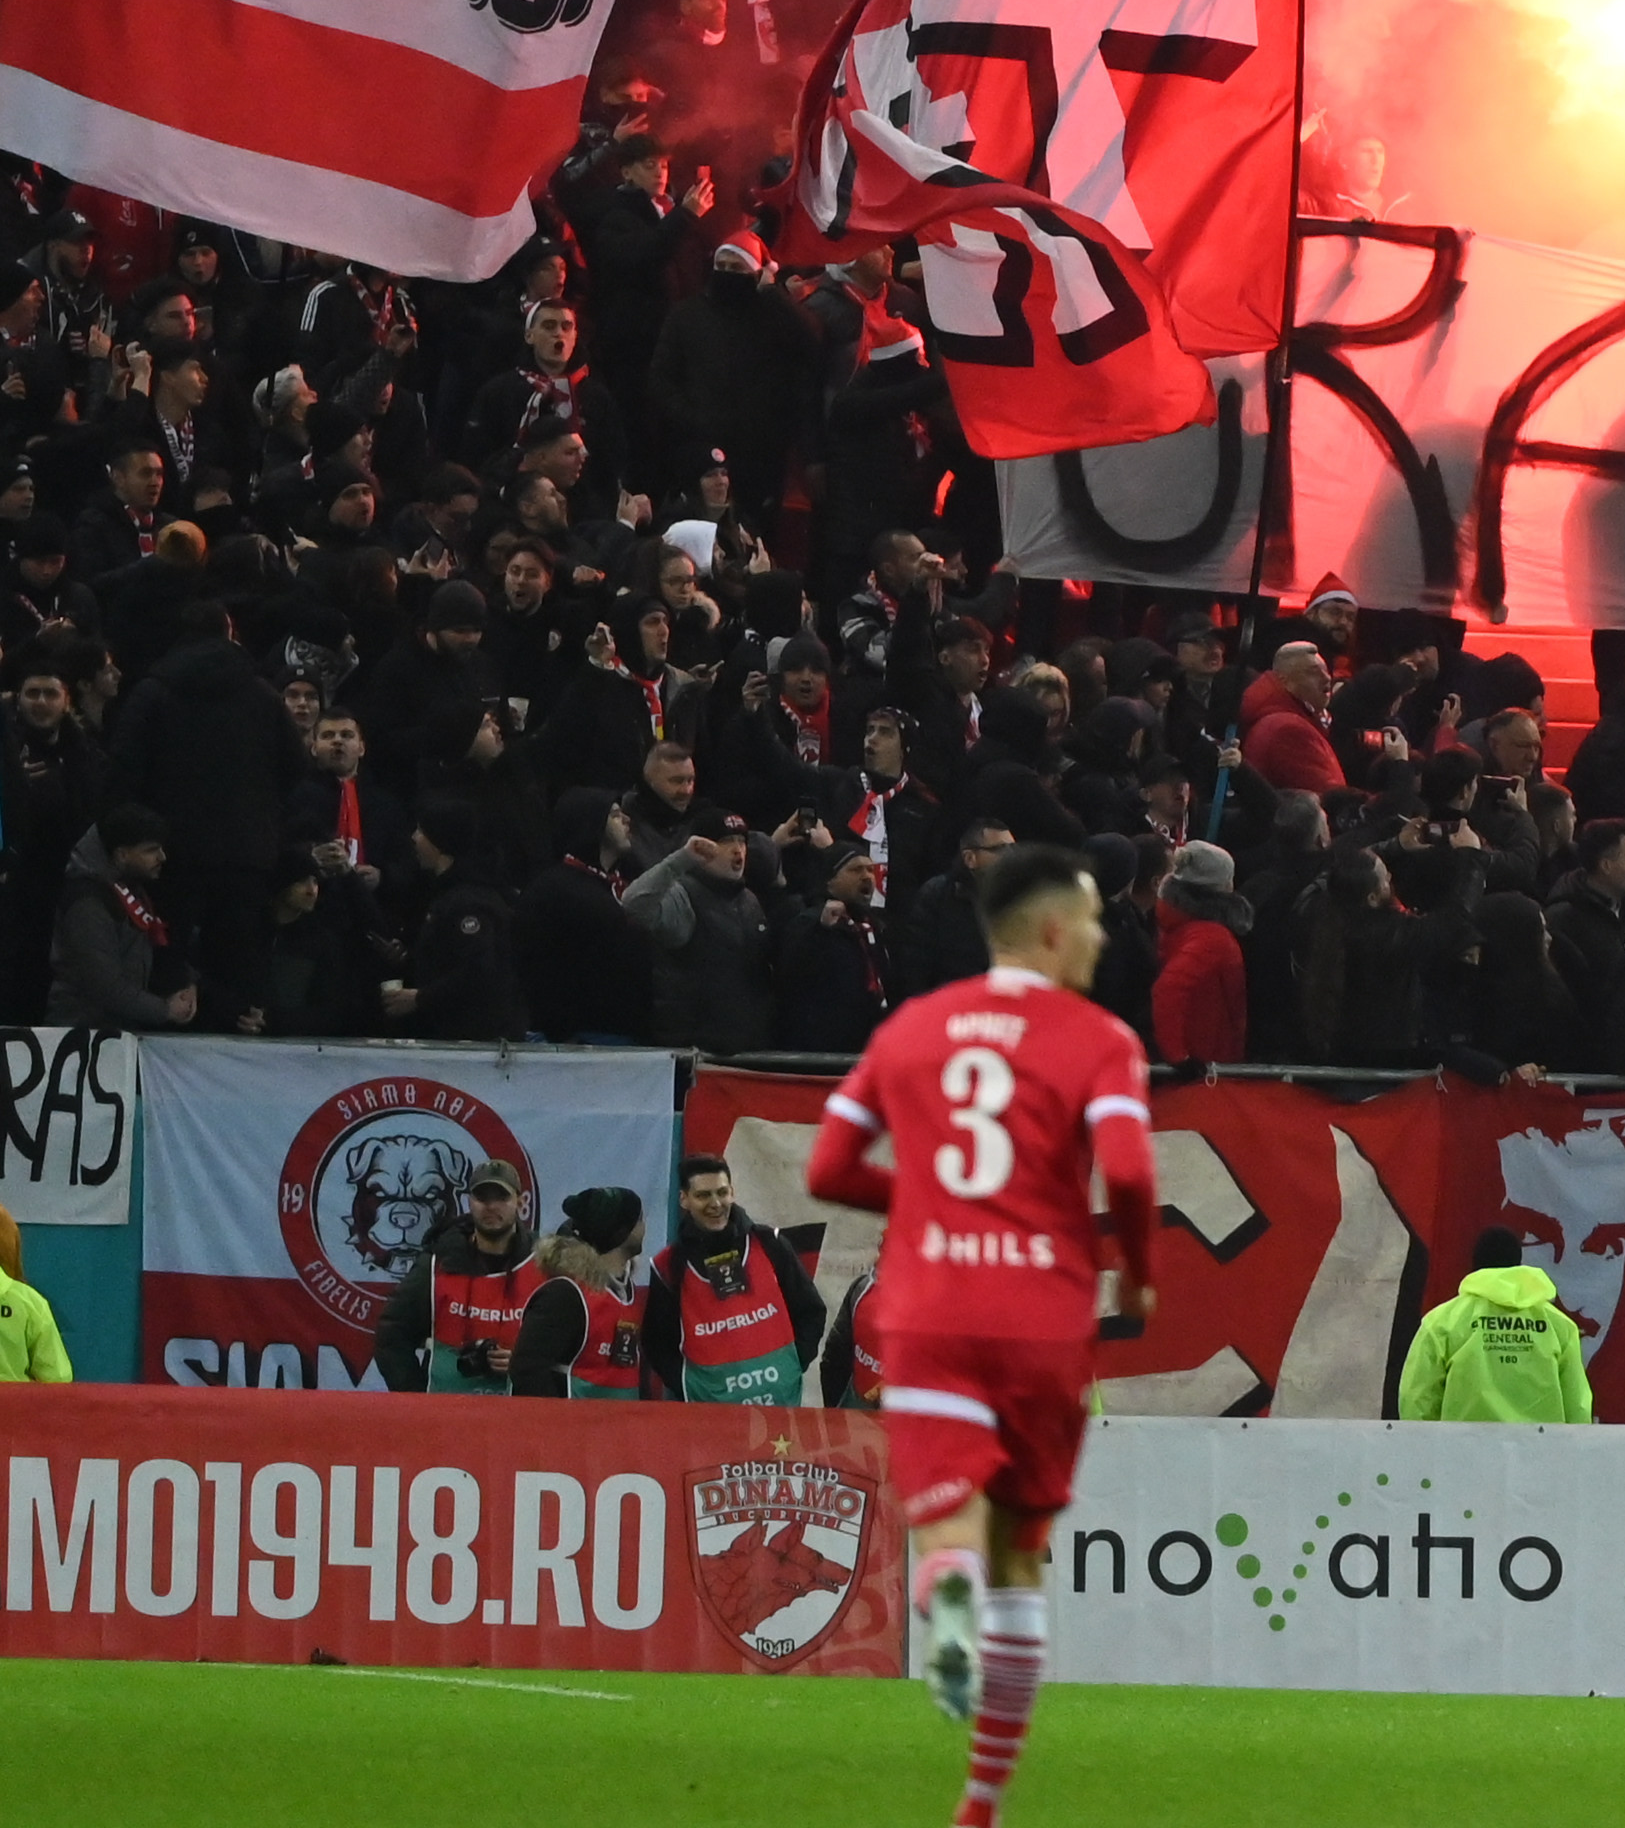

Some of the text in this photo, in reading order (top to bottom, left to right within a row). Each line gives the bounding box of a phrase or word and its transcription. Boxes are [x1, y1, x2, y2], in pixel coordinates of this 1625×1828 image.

[337, 1083, 416, 1121] SIAMO
[934, 1046, 1016, 1200] 3
[303, 1259, 372, 1321] FIDELIS
[694, 1302, 779, 1337] SUPERLIGA
[1483, 1333, 1534, 1344] GENERAL
[725, 1366, 779, 1393] FOTO
[720, 1461, 839, 1484] Fotbal Club
[700, 1476, 862, 1519] DINAMO
[0, 1456, 666, 1633] MO1948.RO
[755, 1638, 796, 1659] 1948
